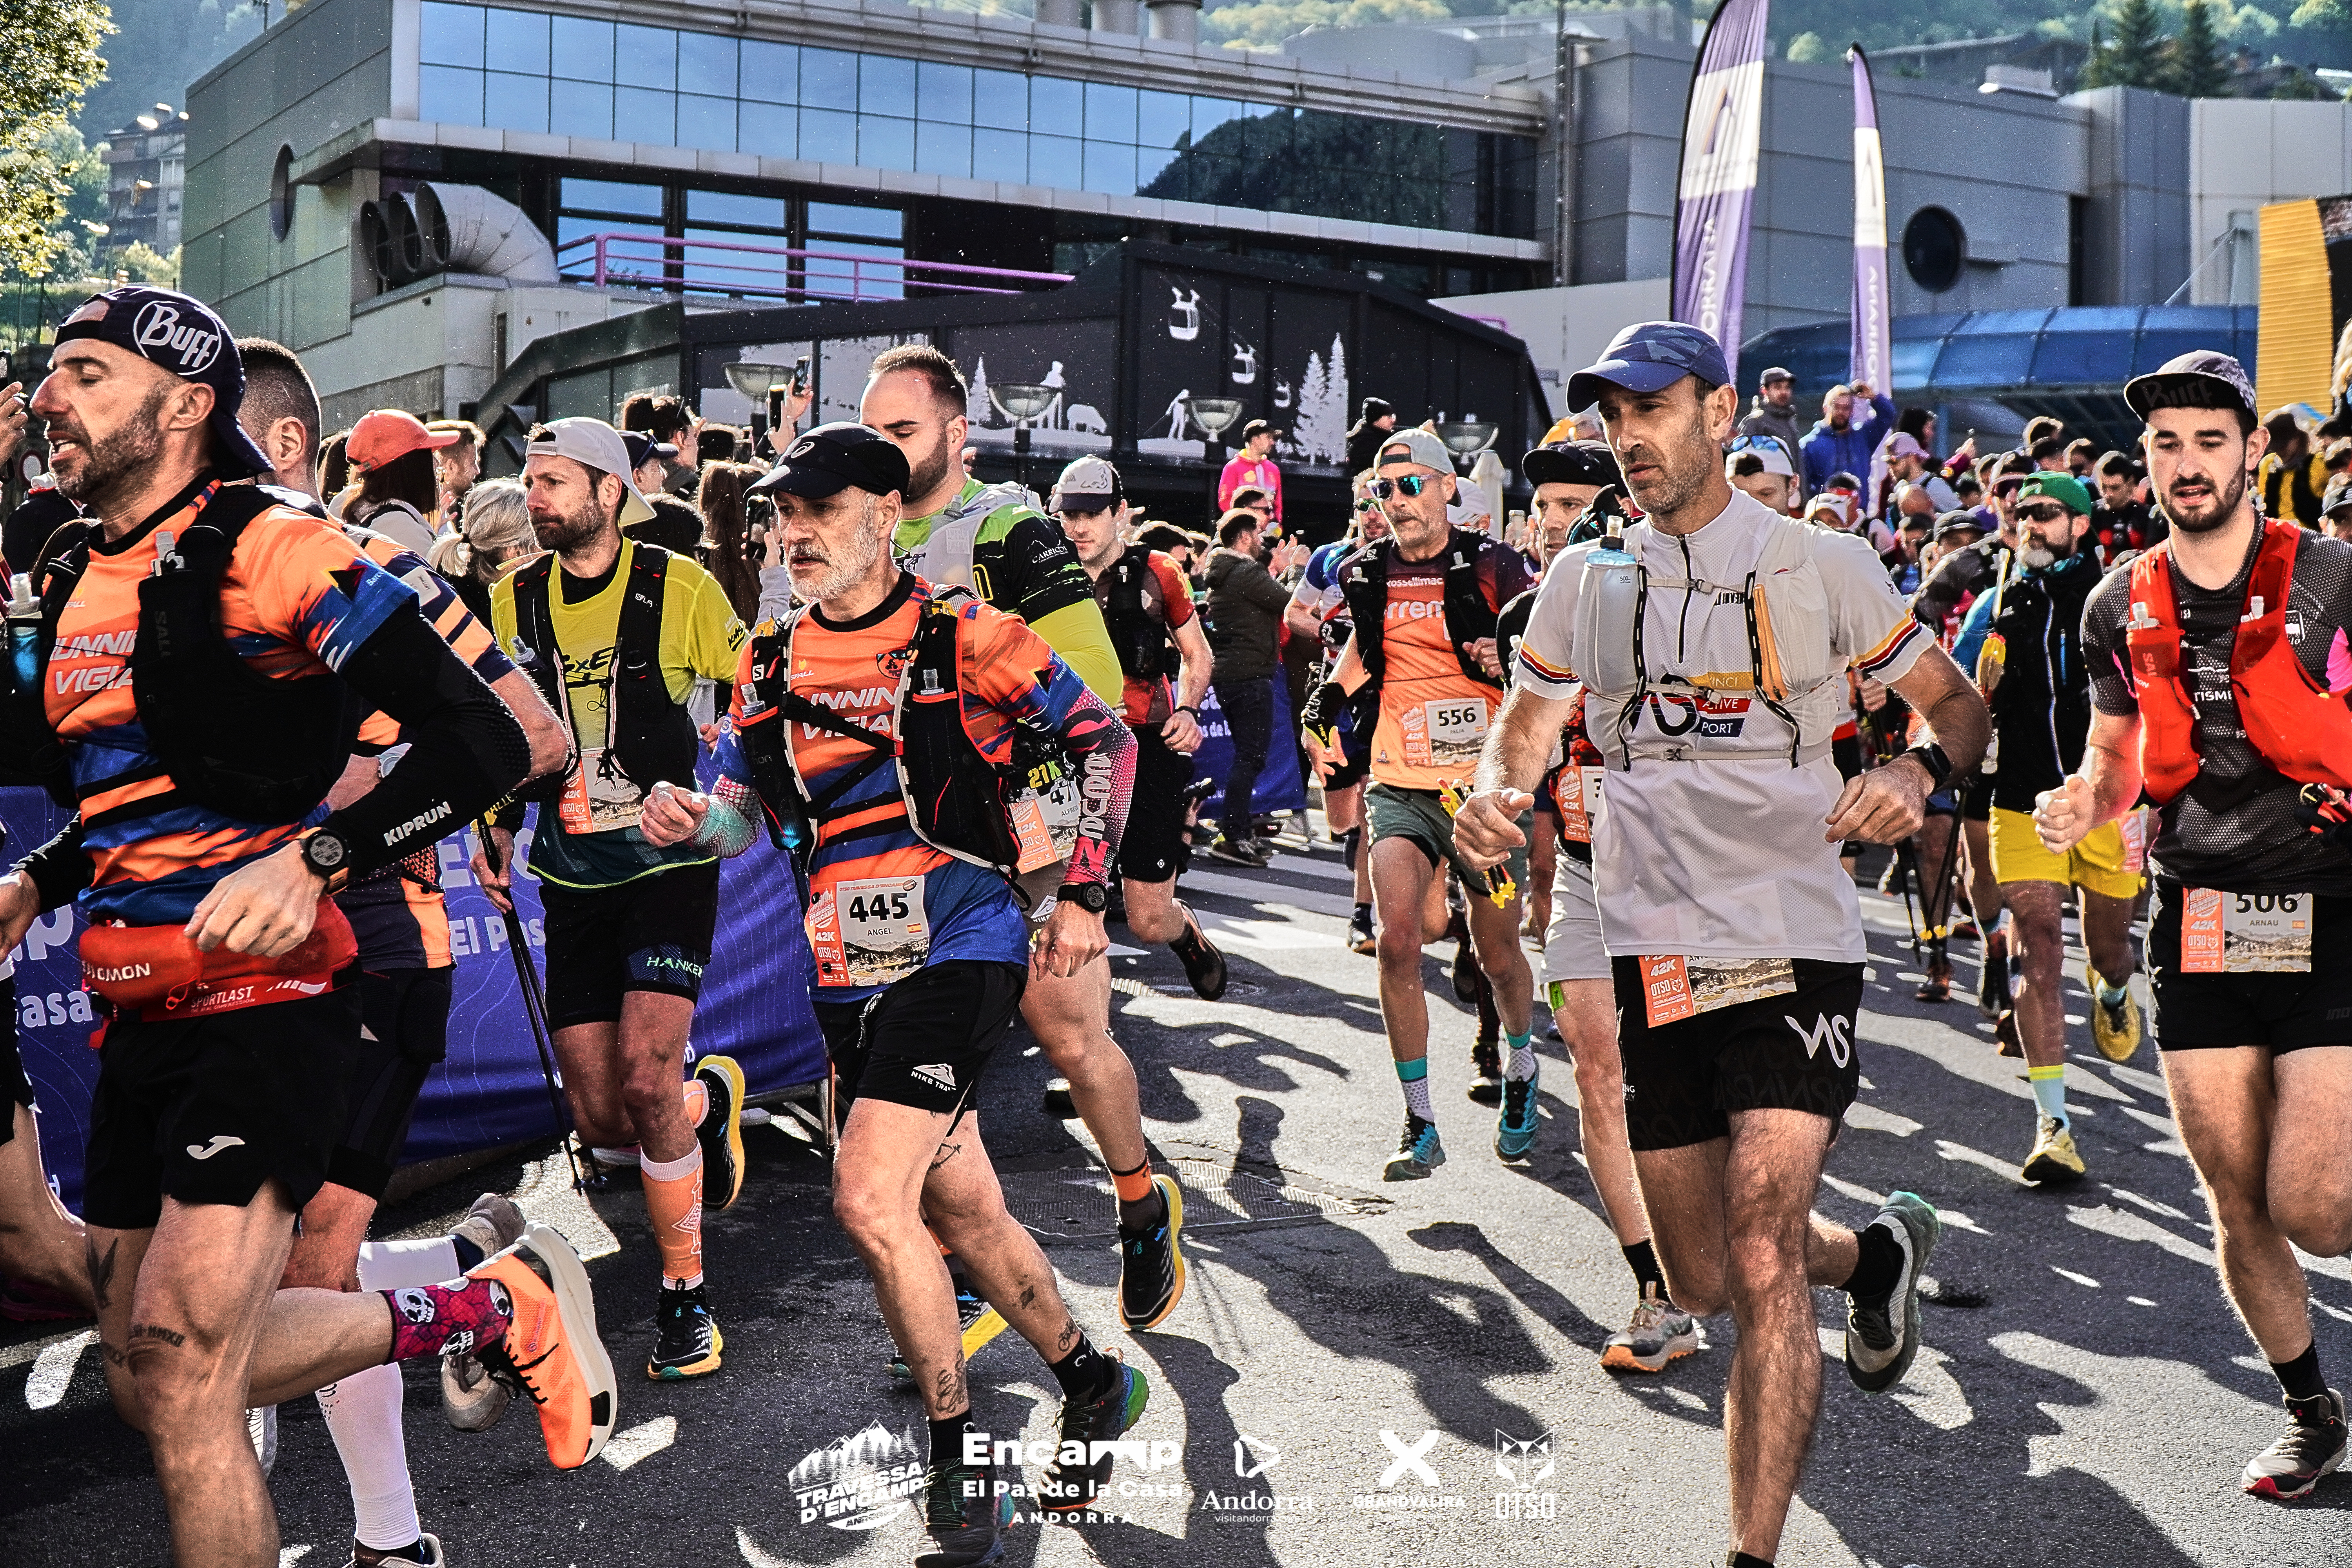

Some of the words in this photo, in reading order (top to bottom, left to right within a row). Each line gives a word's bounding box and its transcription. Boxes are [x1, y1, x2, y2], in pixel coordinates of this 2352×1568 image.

[140, 304, 219, 368] Buff
[1437, 707, 1477, 727] 556
[1028, 760, 1062, 789] 21K
[564, 789, 581, 799] 42K
[610, 782, 635, 792] MIGUEL
[562, 803, 575, 813] OTSO
[1563, 801, 1580, 810] 42K
[383, 801, 452, 846] KIPRUN
[849, 893, 910, 923] 445
[867, 927, 893, 936] ANGEL
[2190, 920, 2218, 930] 42K
[815, 931, 835, 942] 42K
[817, 947, 832, 958] OTSO
[1650, 959, 1677, 978] 42K
[1650, 980, 1671, 997] OTSO
[191, 986, 254, 1009] SPORTLAST
[20, 990, 93, 1028] asa
[911, 1071, 933, 1085] NIKE
